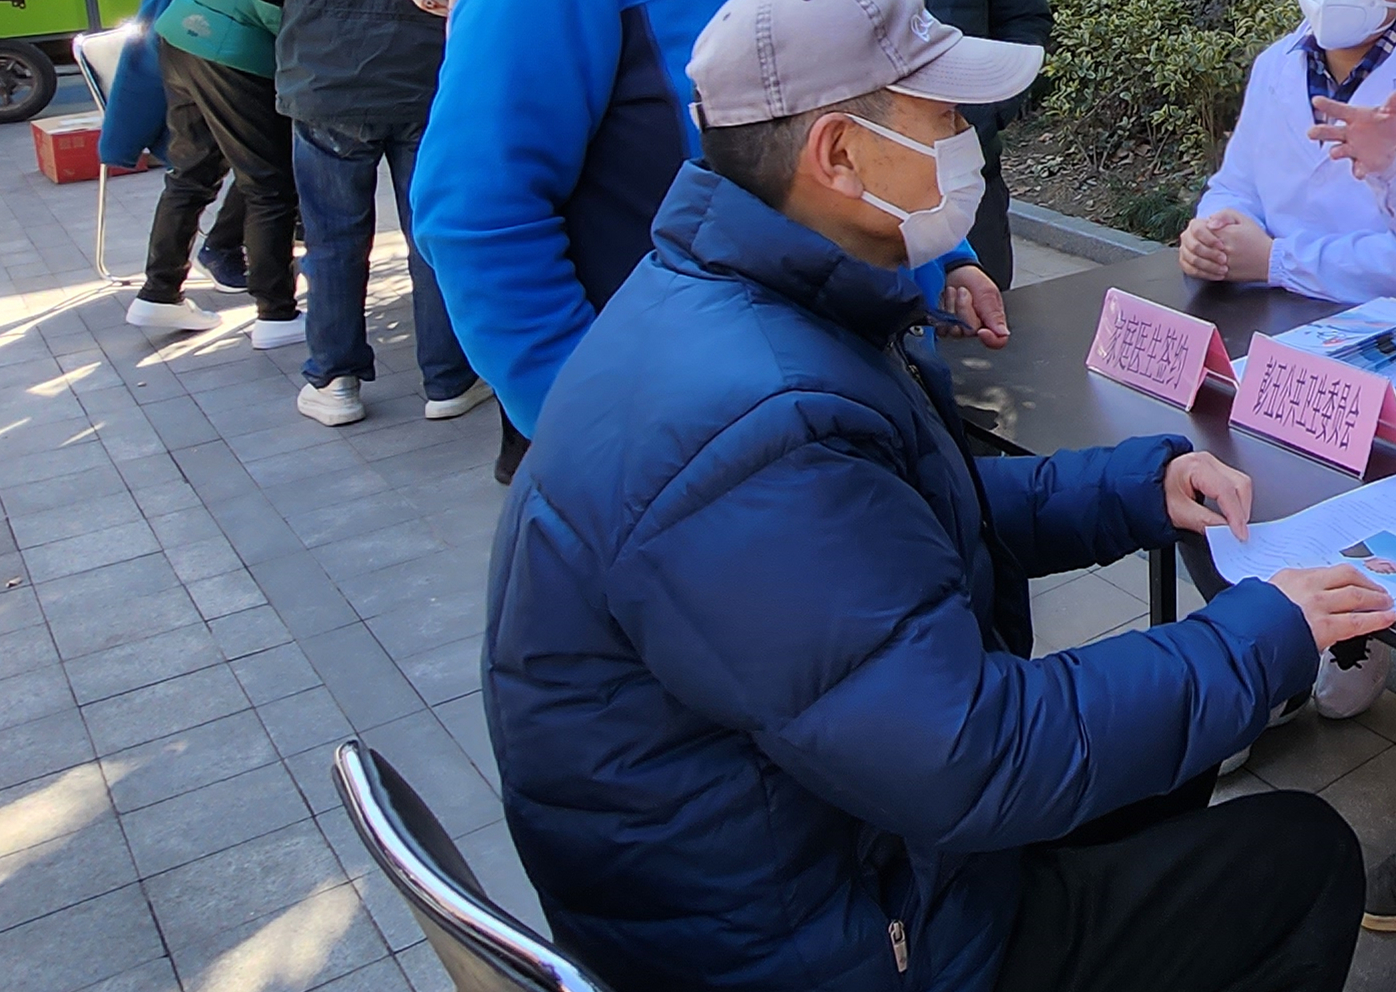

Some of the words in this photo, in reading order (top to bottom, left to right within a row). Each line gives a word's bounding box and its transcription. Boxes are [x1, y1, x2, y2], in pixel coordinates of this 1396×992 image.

[1103, 309, 1189, 389] 家庭医生签约
[1252, 355, 1362, 451] 彭五公共卫生委员会
